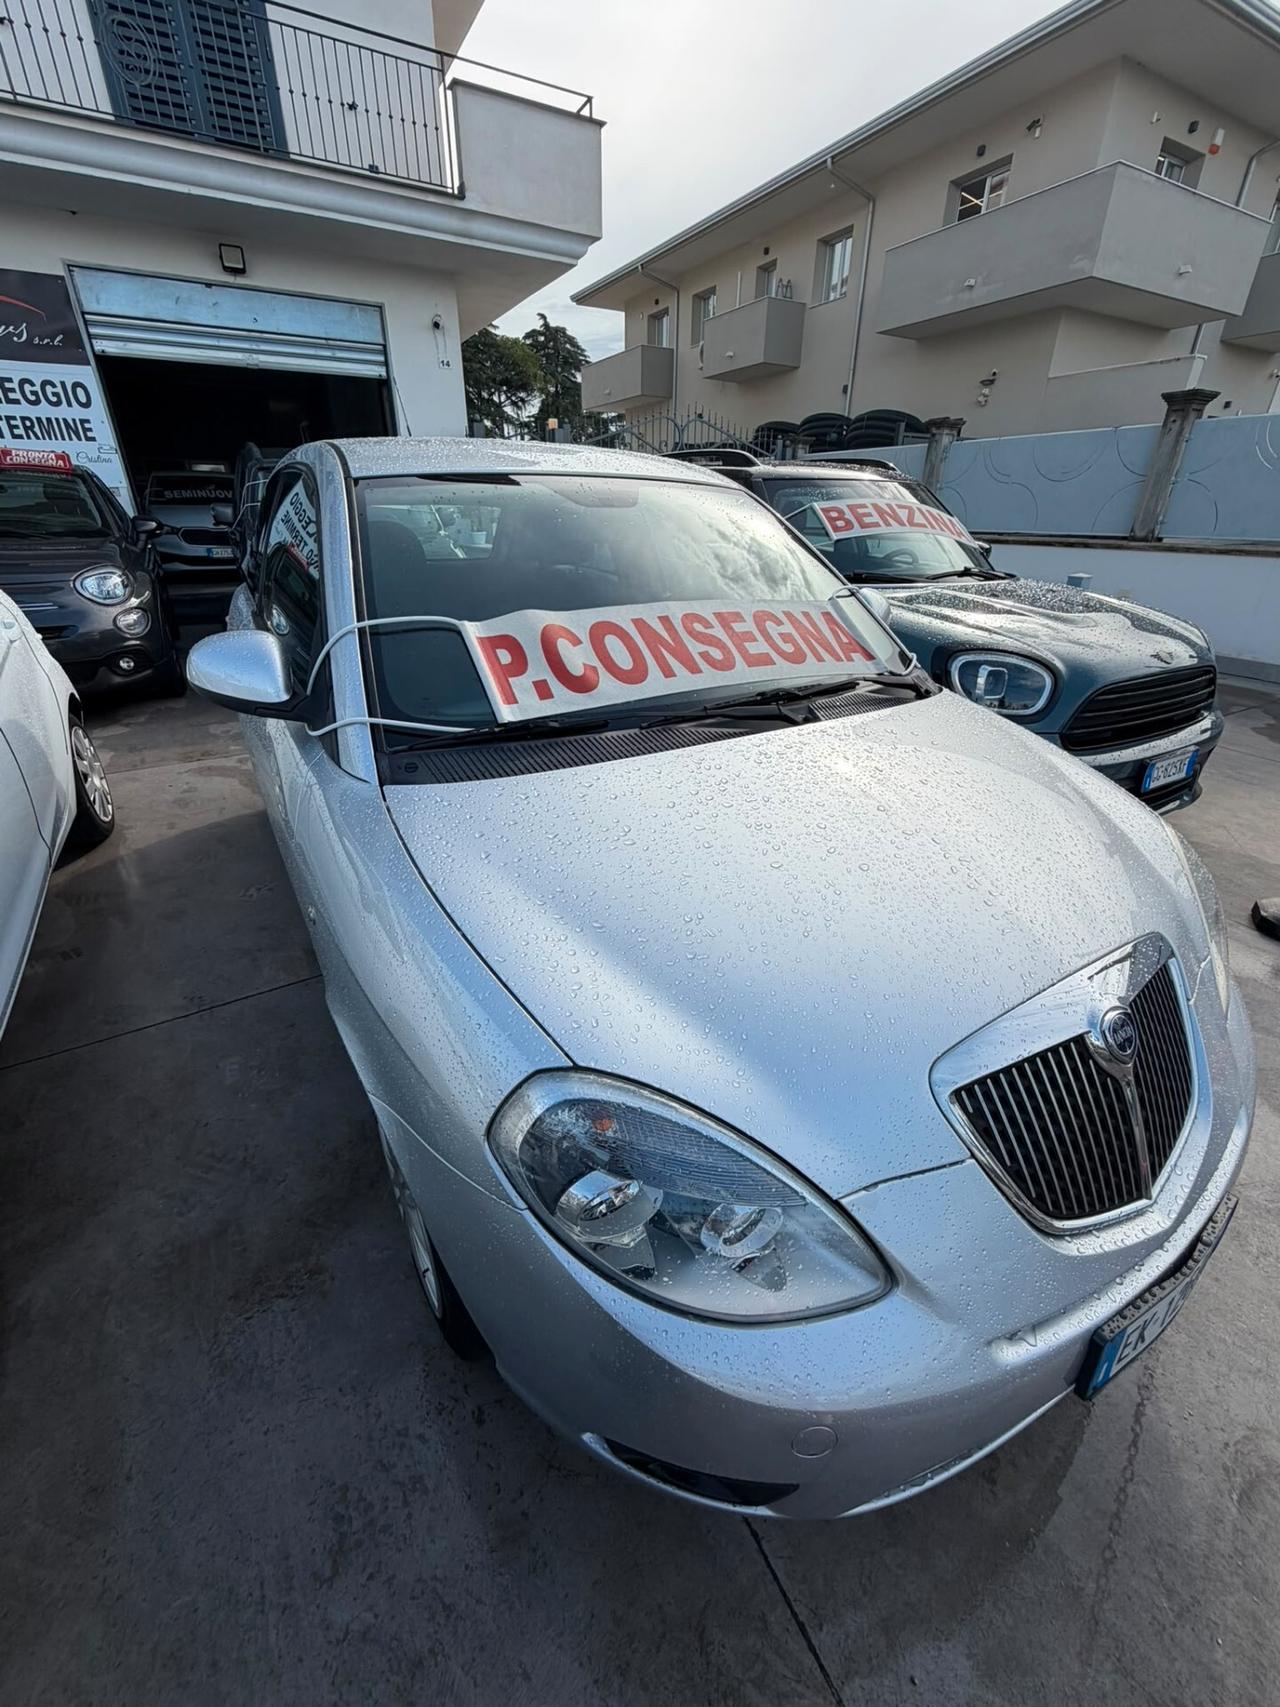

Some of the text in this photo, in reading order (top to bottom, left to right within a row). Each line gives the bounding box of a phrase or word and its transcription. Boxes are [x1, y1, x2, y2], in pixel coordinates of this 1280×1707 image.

[0, 376, 92, 409] EGGIO
[6, 456, 65, 468] CONSEGNA
[11, 449, 56, 460] PRONTA
[820, 502, 966, 540] BENZINA
